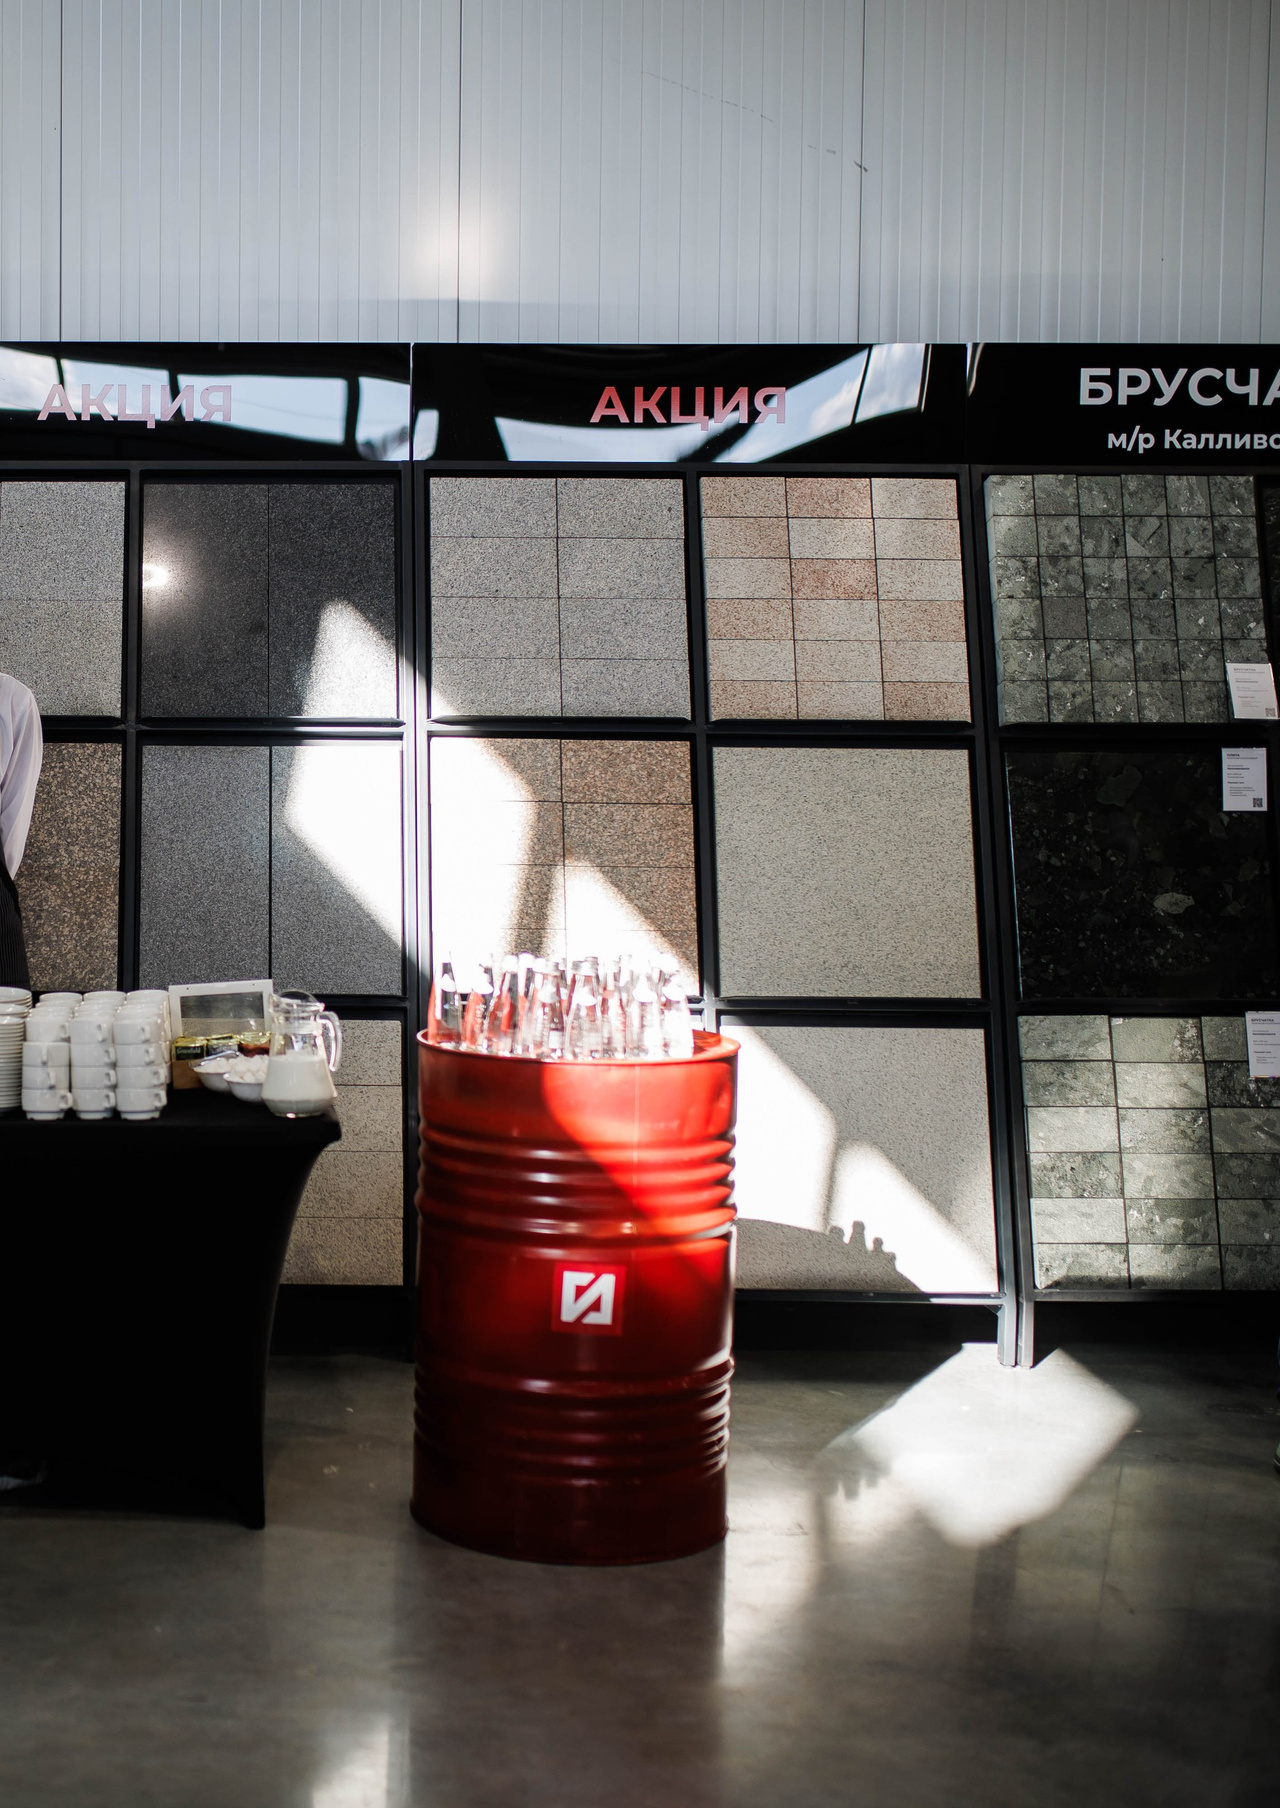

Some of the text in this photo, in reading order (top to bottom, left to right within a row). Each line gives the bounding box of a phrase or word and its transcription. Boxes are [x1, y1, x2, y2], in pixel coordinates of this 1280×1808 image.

[37, 383, 232, 429] АКЦИЯ
[589, 386, 787, 431] АКЦИЯ
[1107, 425, 1155, 454] м/р
